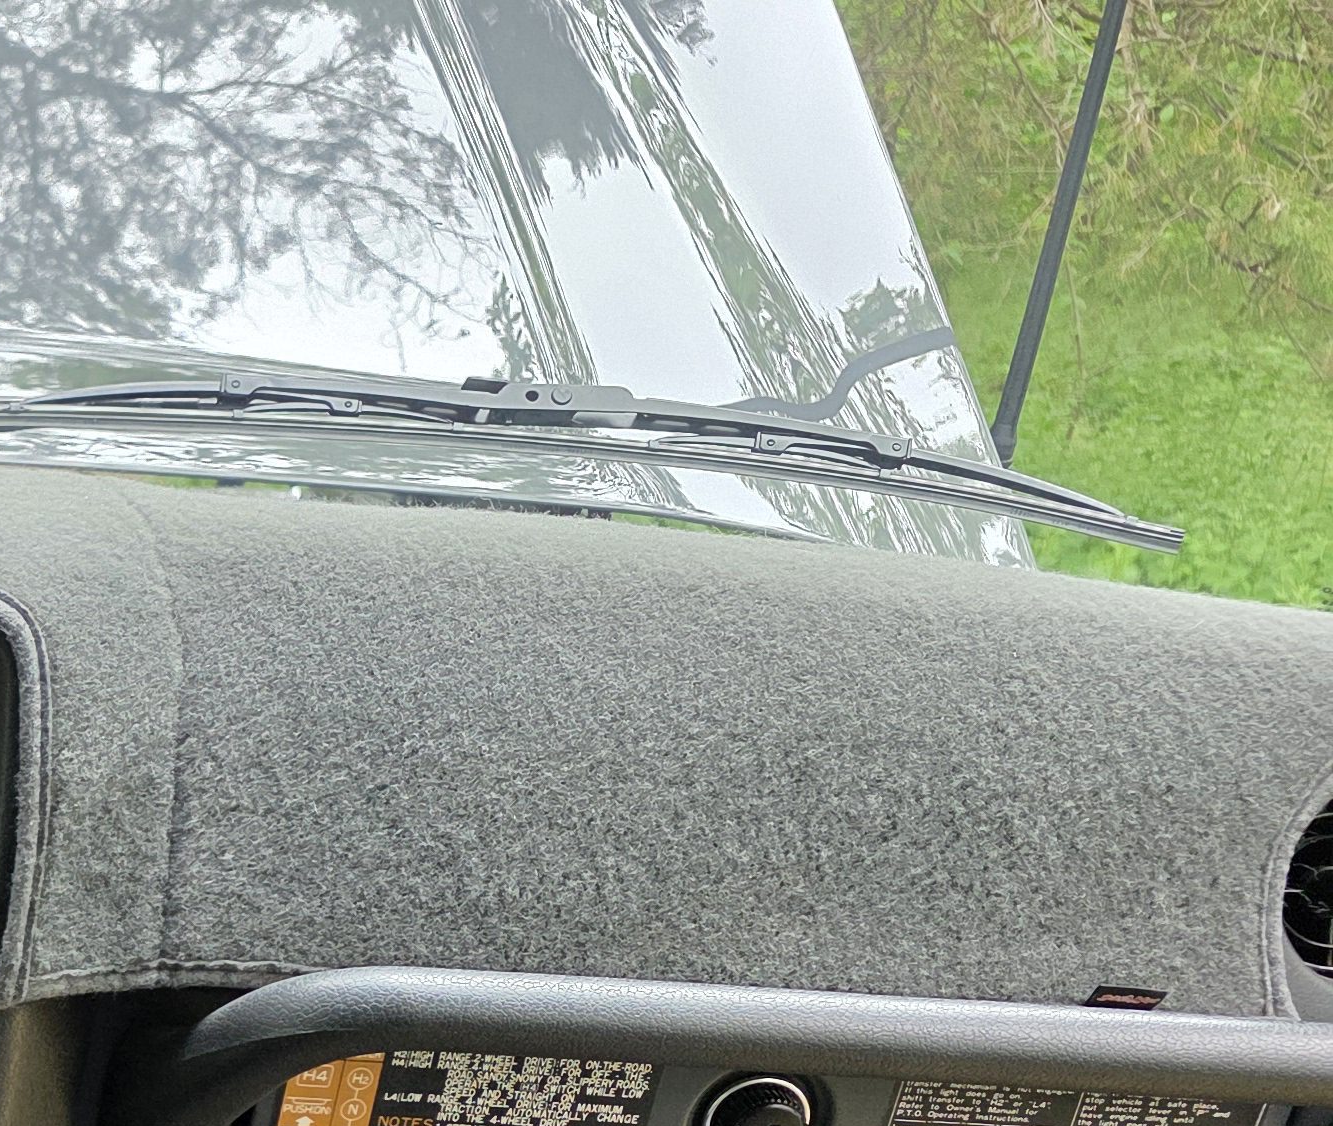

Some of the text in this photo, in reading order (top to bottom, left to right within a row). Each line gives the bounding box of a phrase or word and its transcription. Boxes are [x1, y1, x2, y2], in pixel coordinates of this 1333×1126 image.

[351, 1072, 370, 1085] H2
[560, 1067, 582, 1077] FOR
[591, 1069, 611, 1079] OFF
[624, 1071, 646, 1081] THE
[444, 1079, 490, 1090] OPERATE
[496, 1082, 515, 1091] THE
[542, 1084, 582, 1095] SWITCH
[585, 1086, 616, 1098] WHILE
[621, 1089, 645, 1099] LOW
[546, 1075, 562, 1084] OR
[567, 1076, 615, 1088] SLIPPERY
[615, 1079, 651, 1091] ROADS.
[442, 1087, 477, 1097] SPEED
[480, 1089, 502, 1100] AND
[506, 1090, 556, 1102] STRAIGHT
[346, 1103, 359, 1116] N
[464, 1097, 510, 1109] 4-WHEEL
[576, 1102, 625, 1115] MAXIMUM
[435, 1112, 461, 1122] INTO
[466, 1114, 486, 1124] THE
[489, 1115, 534, 1126] 4-WHEEL
[505, 1107, 589, 1121] AUTOMATICALLY
[596, 1113, 640, 1125] CHANGE
